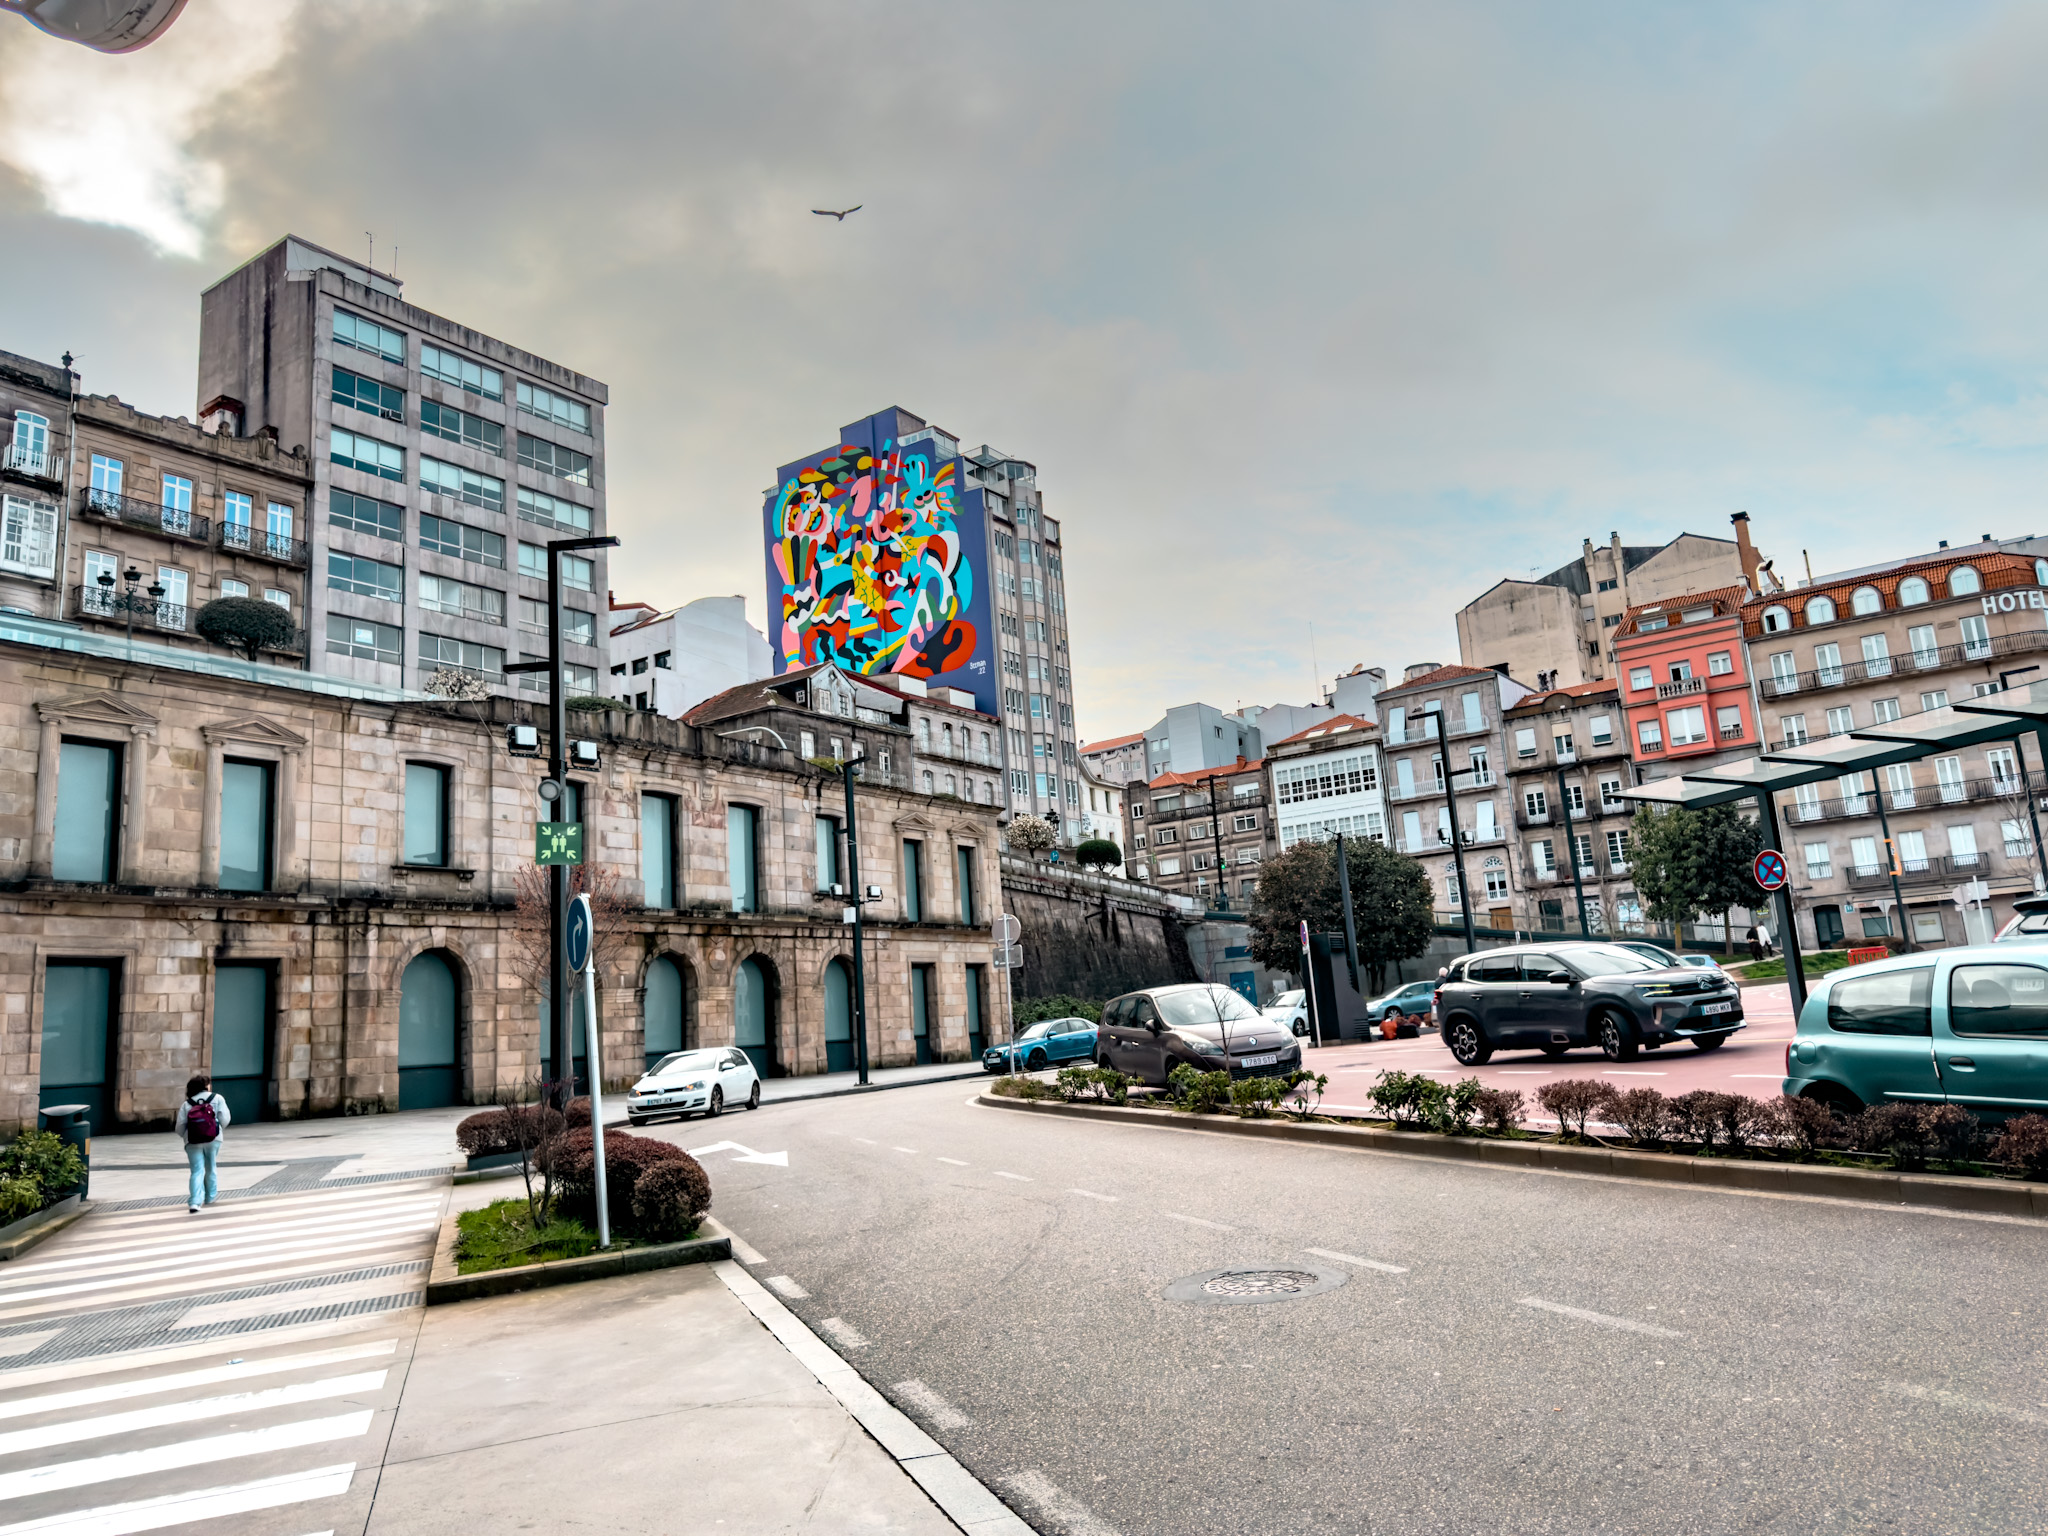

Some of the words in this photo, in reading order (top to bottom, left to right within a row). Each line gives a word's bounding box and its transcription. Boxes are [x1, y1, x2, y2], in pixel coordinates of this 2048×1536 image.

[1981, 591, 2048, 615] HOTEL
[1706, 1005, 1719, 1013] 4890
[1246, 1058, 1261, 1066] 1789
